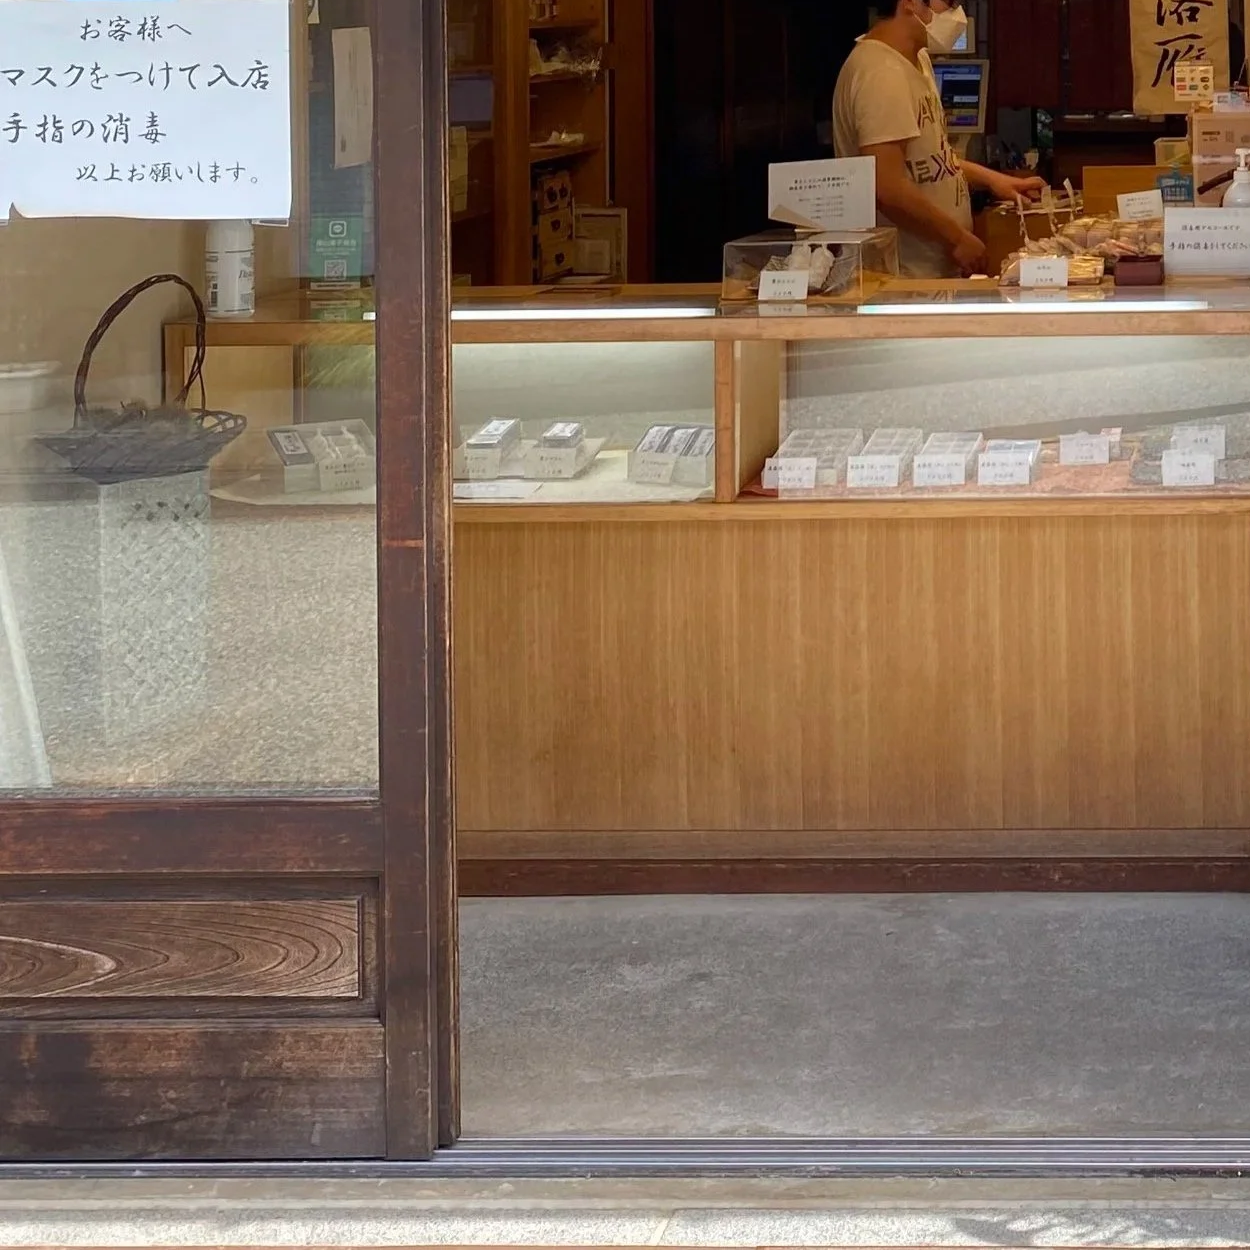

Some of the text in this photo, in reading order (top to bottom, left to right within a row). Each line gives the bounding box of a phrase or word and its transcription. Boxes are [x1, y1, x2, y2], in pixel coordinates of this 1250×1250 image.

[79, 15, 192, 42] お客様へ
[0, 59, 272, 91] マスクをつけて入店
[2, 111, 167, 145] 手指の消毒
[75, 161, 258, 185] 以上お願いします。
